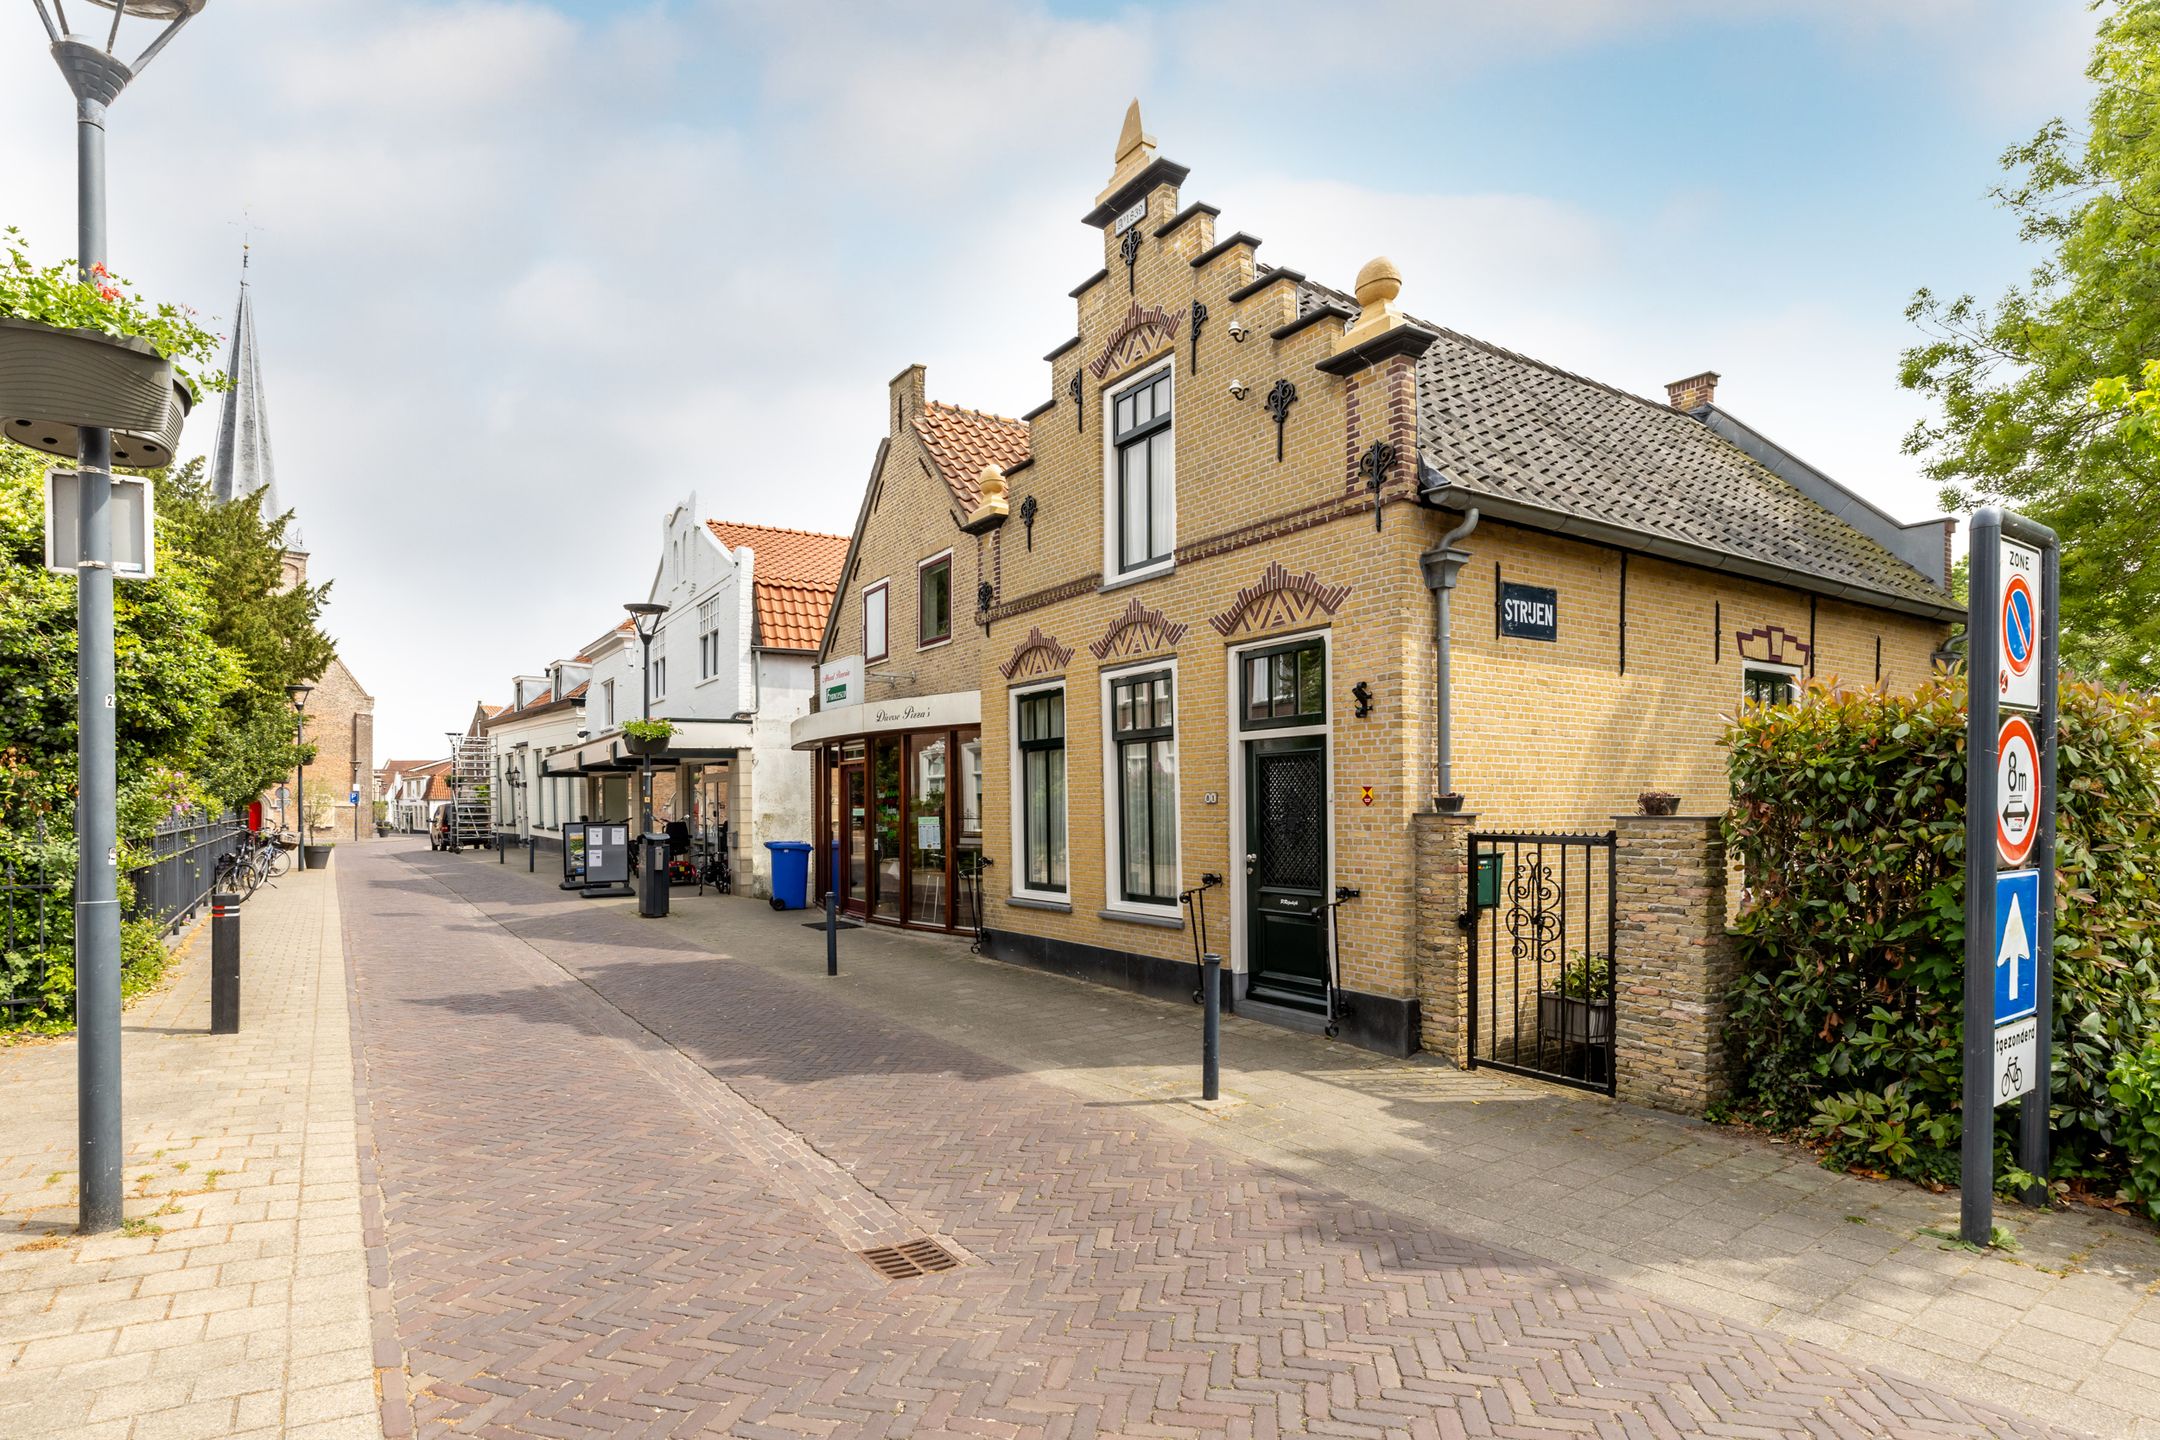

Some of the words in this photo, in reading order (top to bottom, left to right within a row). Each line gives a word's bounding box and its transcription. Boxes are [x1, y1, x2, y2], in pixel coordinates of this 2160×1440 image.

[2009, 551, 2030, 571] ZONE
[876, 709, 900, 722] Diverse
[902, 705, 931, 720] Pizza's
[1996, 1024, 2035, 1055] tgezonderd
